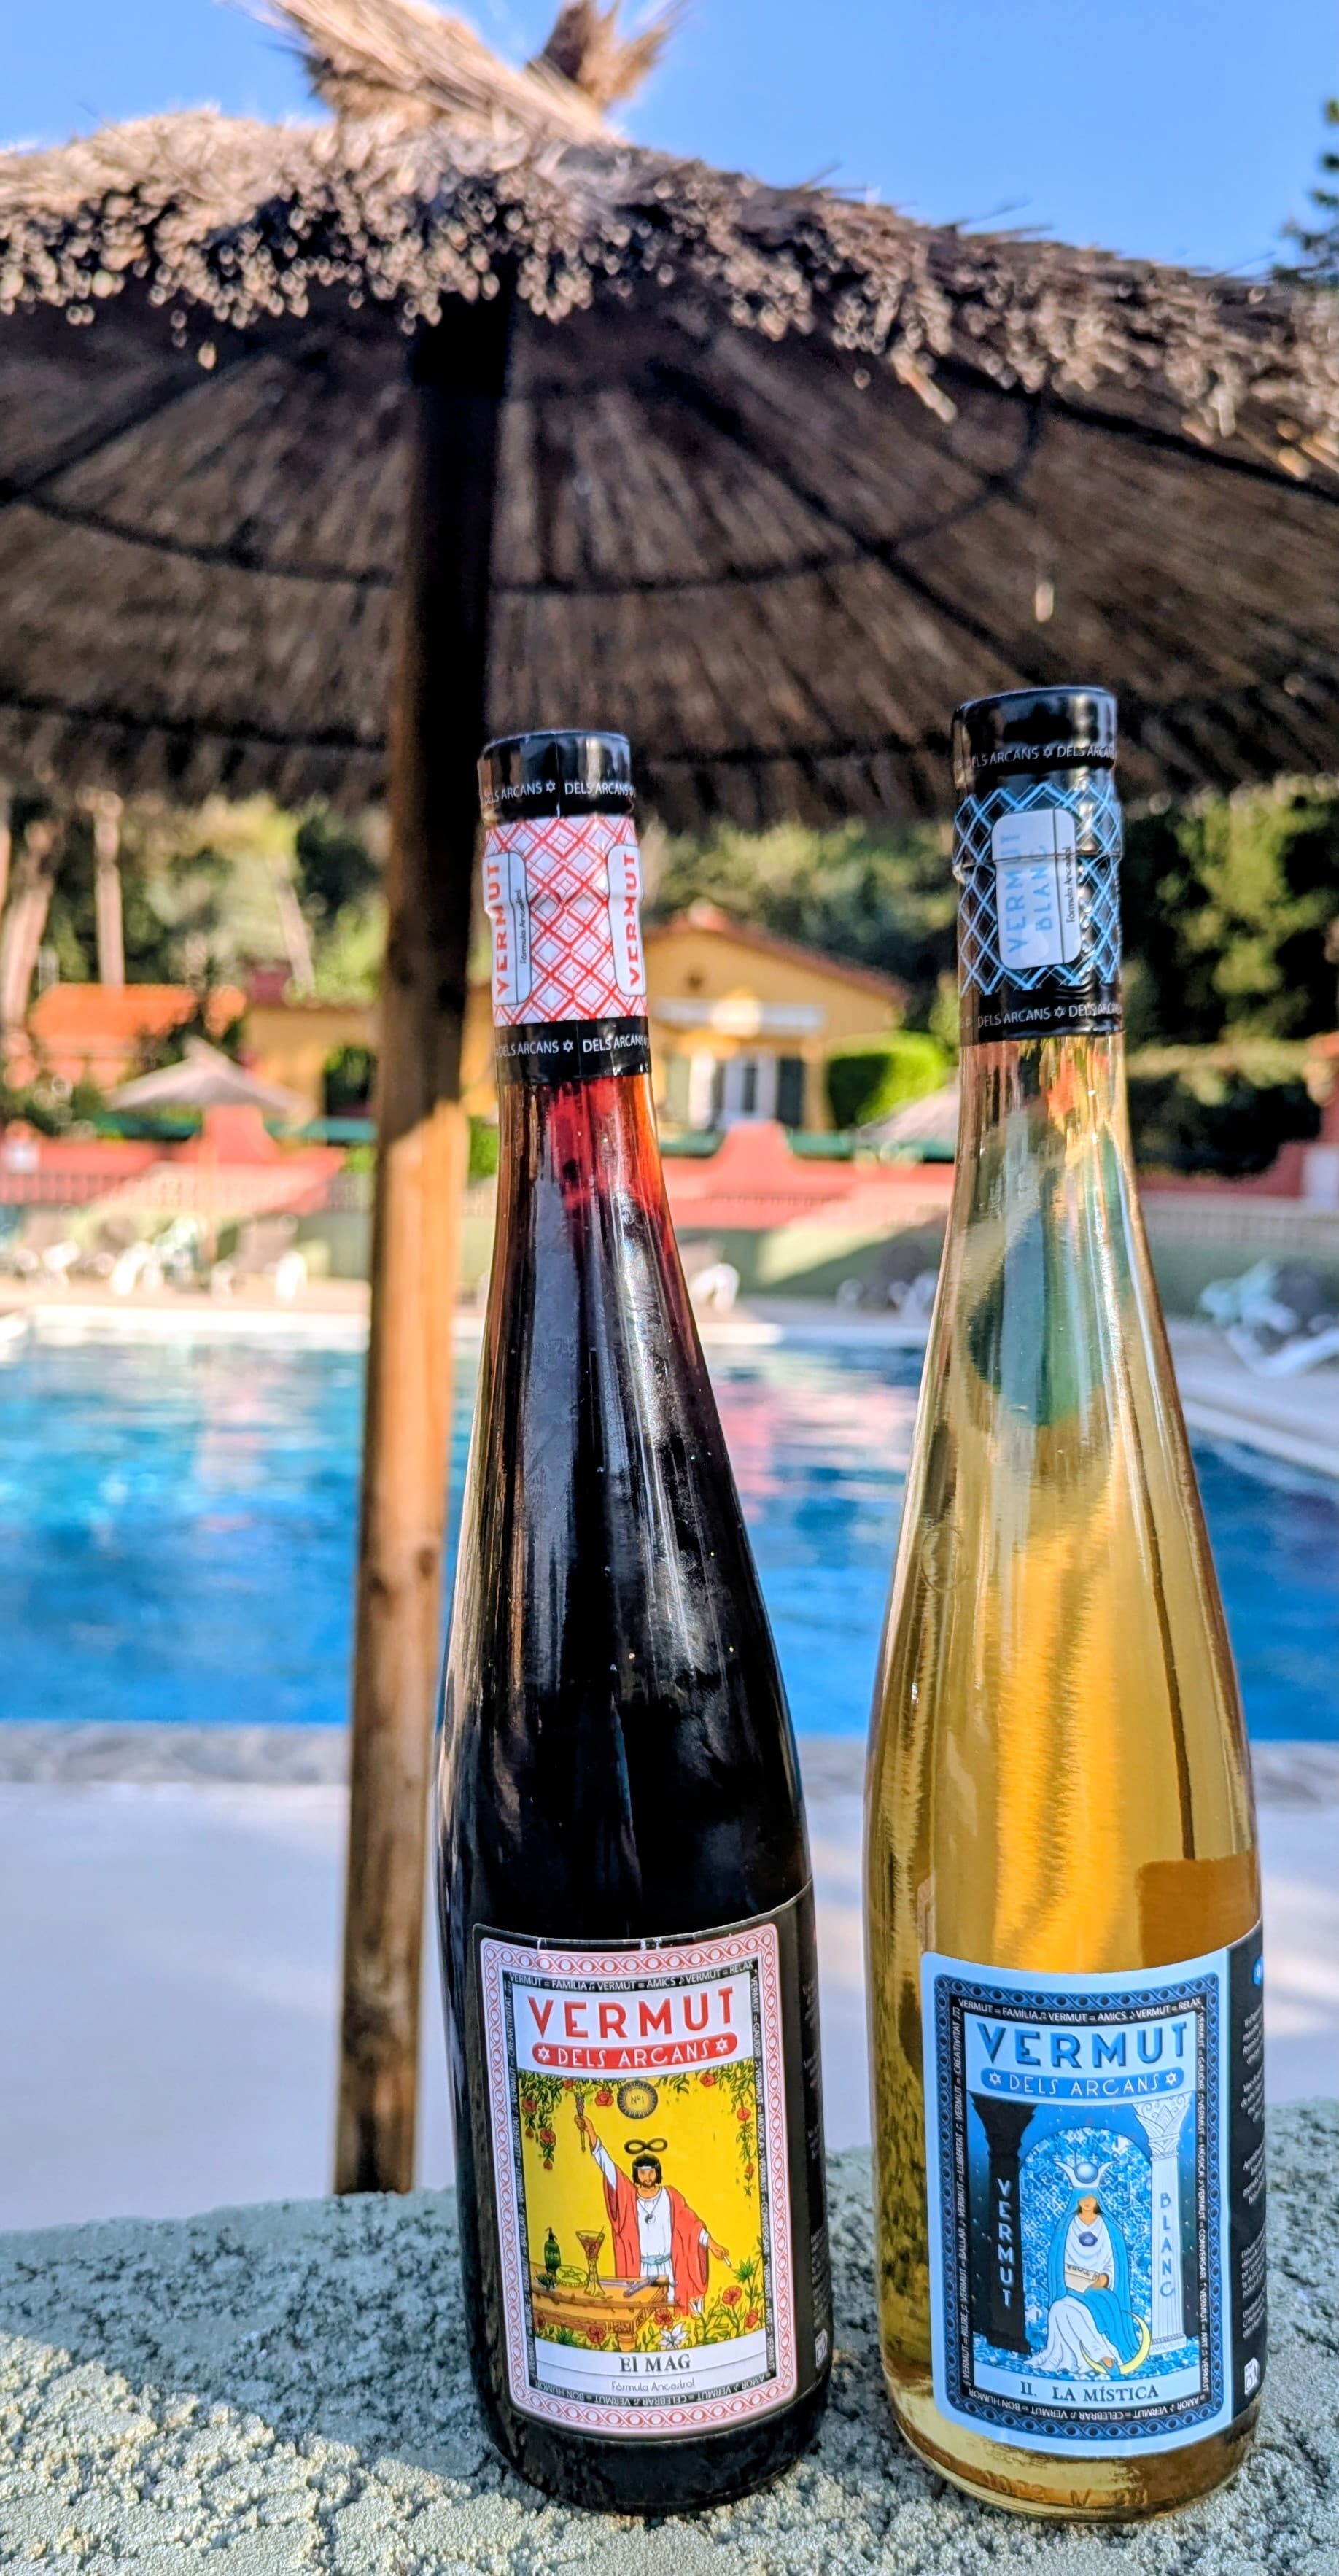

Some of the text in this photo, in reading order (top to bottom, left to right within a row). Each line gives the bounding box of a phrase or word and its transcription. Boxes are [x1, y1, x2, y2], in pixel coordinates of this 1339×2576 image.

[989, 747, 1039, 765] ARCANS
[1057, 745, 1085, 758] DELS
[501, 781, 542, 800] ARCANS
[564, 782, 592, 795] DELS
[595, 781, 629, 796] ARCANS
[1001, 834, 1028, 953] VERMUT
[1029, 845, 1052, 931] BLANC
[487, 865, 509, 996] VERMUT
[624, 853, 640, 987] VERMUT
[977, 1014, 1001, 1028] DELS
[1003, 1006, 1051, 1024] ARCANS
[1069, 1004, 1097, 1017] DELS
[499, 1033, 643, 1058] DELS ARCANS DELS ARCANS
[510, 1973, 543, 1986] VERMUT
[597, 1981, 636, 1990] VERMUT
[647, 1977, 675, 1988] AMICS
[686, 1969, 721, 1983] VERMUT
[730, 1960, 753, 1974] RELAX
[751, 1976, 760, 2013] VERMUT
[958, 1998, 993, 2013] VERMUT
[1049, 2013, 1087, 2022] VERMUT
[1098, 2011, 1126, 2021] AMICS
[1136, 2006, 1171, 2018] VERMUT
[1179, 1997, 1202, 2010] RELAX
[528, 1986, 734, 2039] VERMUT
[753, 2023, 761, 2057] GAUDIR
[977, 2020, 1187, 2068] VERMUT
[1197, 2012, 1205, 2047] VERMUT
[558, 2040, 709, 2068] DELS ARCANS
[952, 2020, 961, 2074] CREATIVITAT
[509, 2067, 518, 2103] VERMUT
[755, 2068, 764, 2103] VERMUT
[1009, 2073, 1160, 2096] DELS ARCANS
[954, 2084, 963, 2120] VERMUT
[955, 2132, 964, 2175] LLIBERTAT
[758, 2156, 767, 2192] VERMUT
[957, 2182, 965, 2217] VERMUT
[1198, 2185, 1206, 2220] VERMUT
[760, 2201, 770, 2253] CONVERSAR
[998, 2178, 1015, 2309] VERMUT
[1160, 2192, 1175, 2297] BLANC
[764, 2264, 772, 2299] VERMUT
[959, 2268, 967, 2302] VERMUT
[765, 2308, 773, 2324] ART
[960, 2313, 969, 2337] RIURE
[618, 2354, 691, 2373] El MAG
[766, 2334, 775, 2370] VERMUT
[961, 2345, 970, 2378] VERMUT
[534, 2380, 564, 2396] HUMOR
[564, 2390, 584, 2400] BON
[611, 2376, 694, 2392] Fórmula Ancestral
[696, 2385, 732, 2400] VERMUT
[741, 2374, 764, 2389] AMOR
[1020, 2381, 1158, 2402] II. LA MÍSTICA
[594, 2395, 630, 2405] VERMUT
[643, 2395, 687, 2405] CELEBRAR
[969, 2389, 1001, 2405] HUMOR
[1002, 2400, 1021, 2411] BON
[1031, 2406, 1068, 2418] VERMUT
[1133, 2405, 1168, 2418] VERMUT
[1177, 2395, 1199, 2410] AMOR
[1079, 2411, 1124, 2420] CELEBRAR
